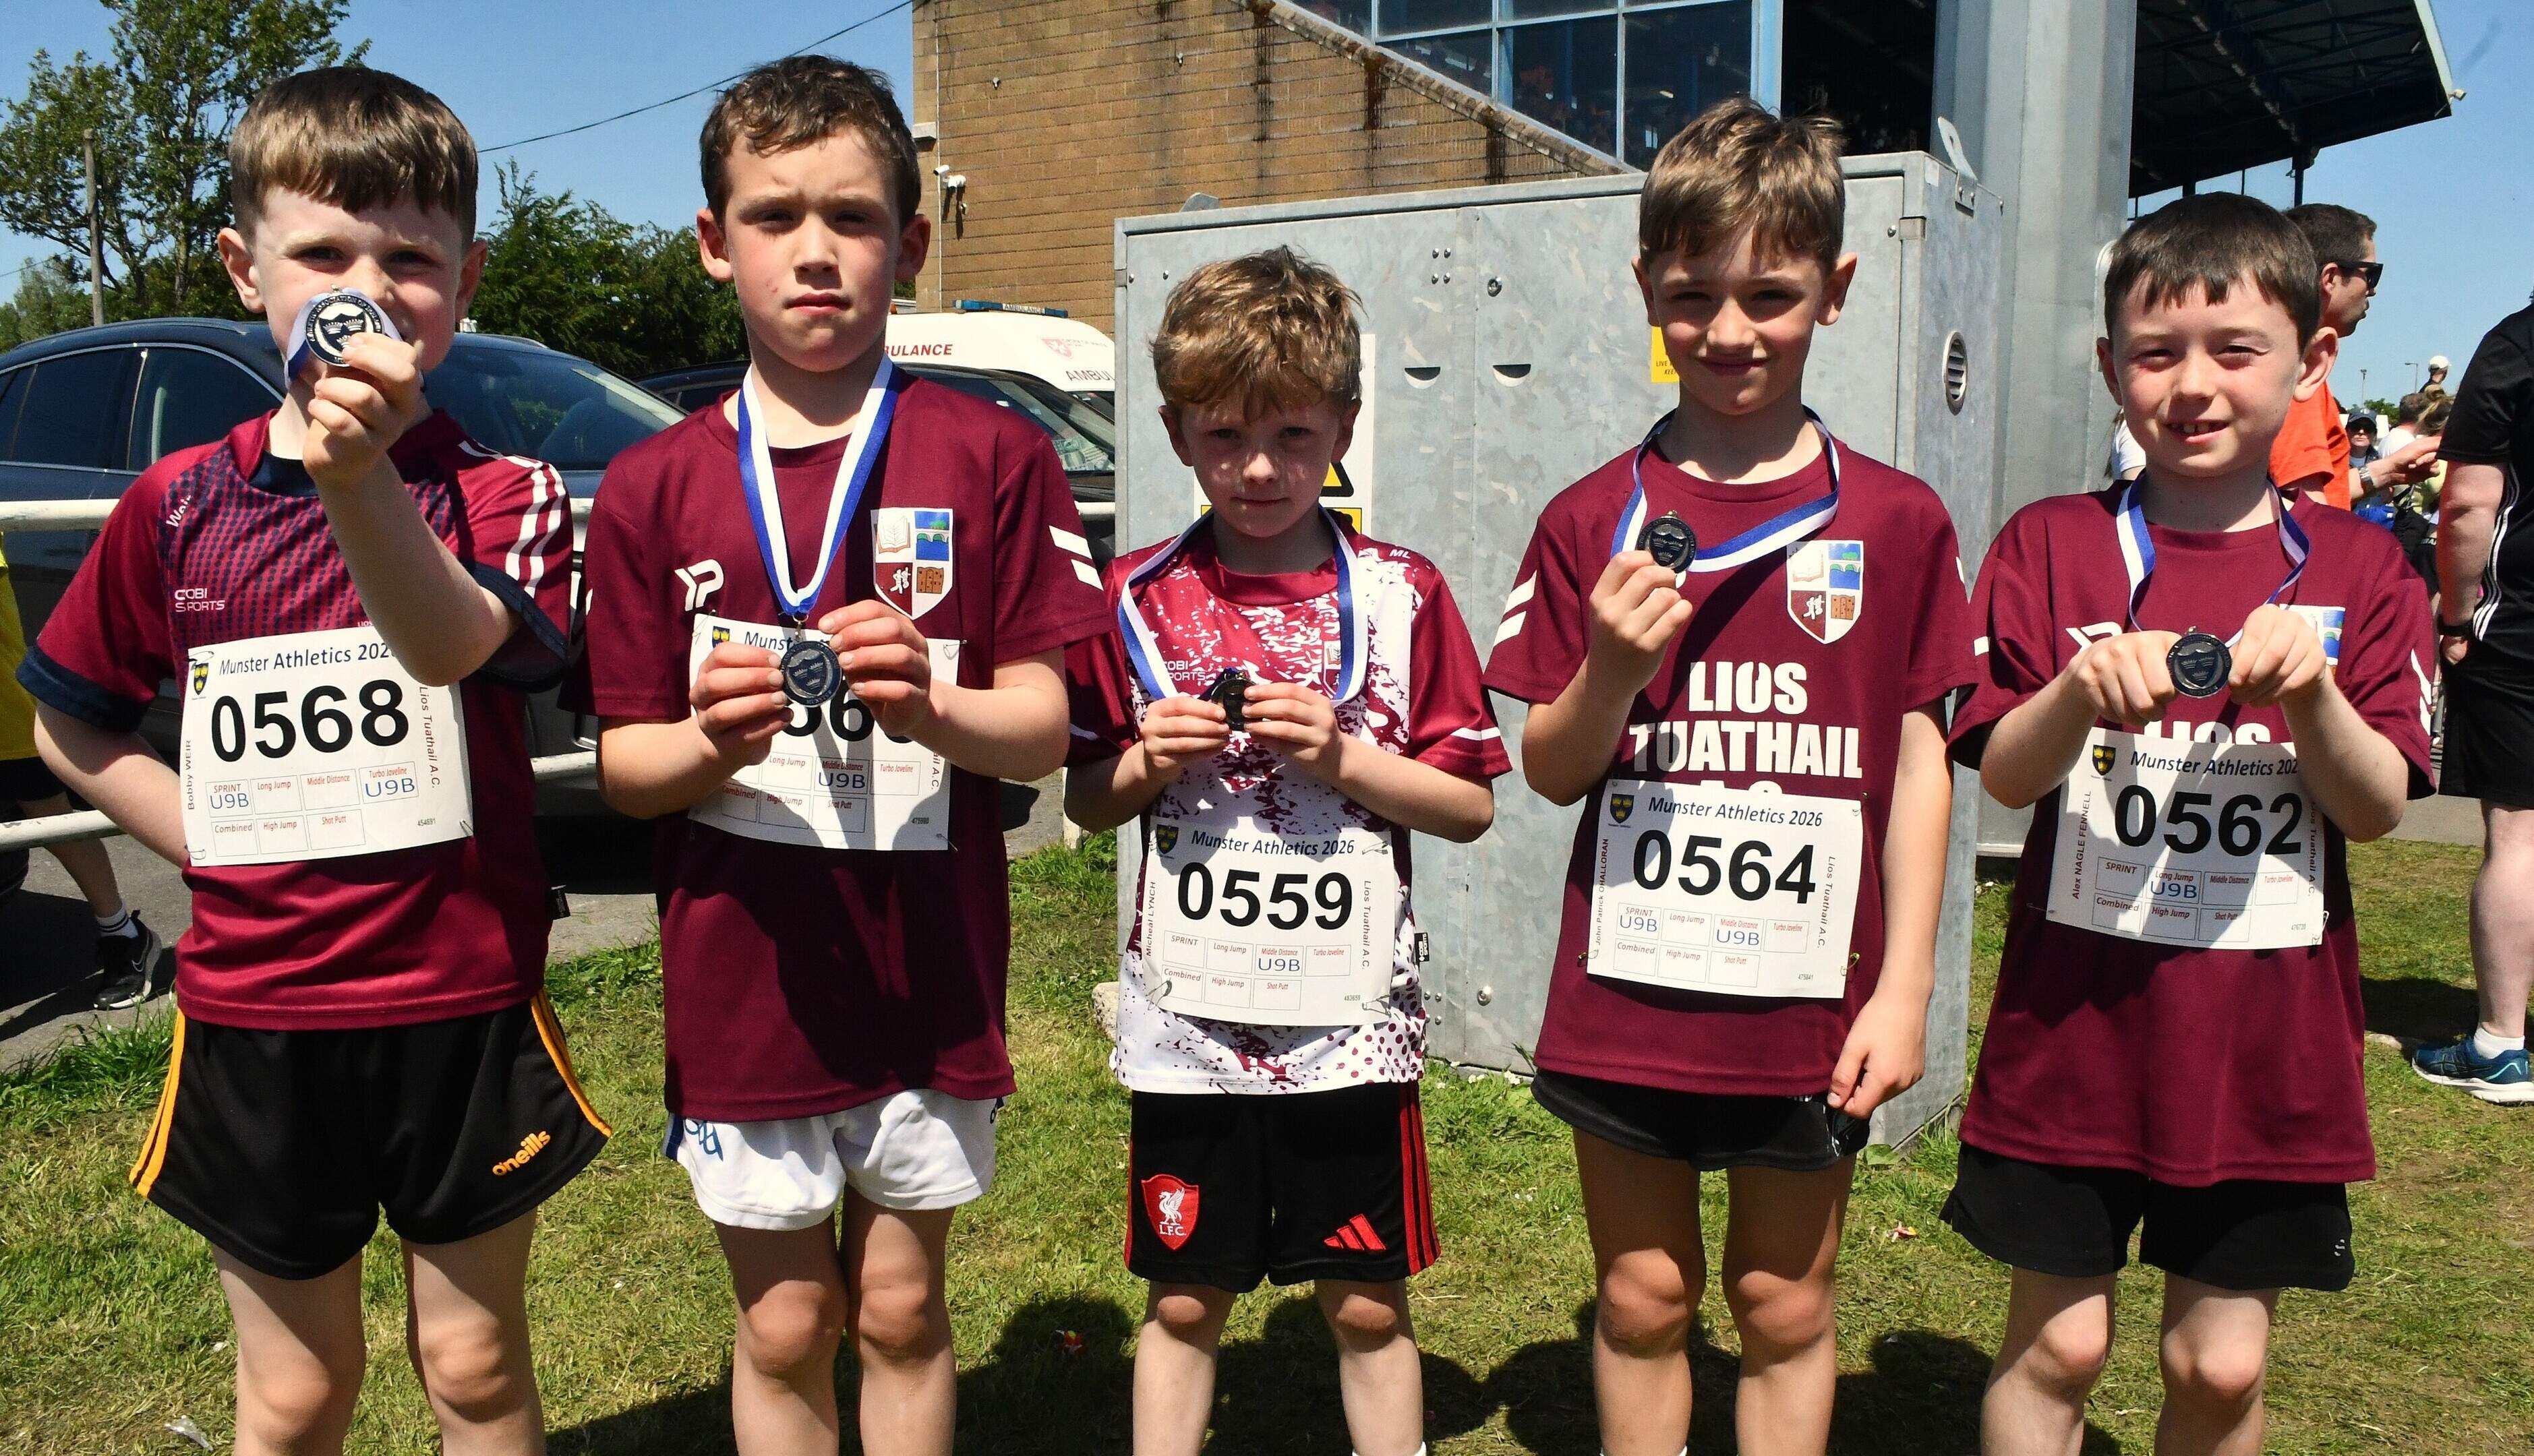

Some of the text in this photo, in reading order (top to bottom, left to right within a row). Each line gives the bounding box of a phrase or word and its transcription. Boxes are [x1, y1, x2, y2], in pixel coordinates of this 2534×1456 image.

[885, 344, 953, 357] BULANCE
[1065, 370, 1115, 381] AMBUL
[1389, 549, 1411, 559] ML
[174, 588, 208, 601] COBI
[175, 600, 225, 612] SPORTS
[744, 631, 793, 651] Munst
[219, 642, 390, 675] Munster Athletics 202
[1164, 660, 1188, 671] OBI
[1169, 671, 1206, 681] PORTS
[1688, 661, 1808, 715] LIOS
[211, 679, 409, 762] 0568
[419, 686, 440, 789] Lios Tuathail A.C.
[1628, 719, 1863, 779] TUATHAIL
[769, 755, 806, 768] Long Jump
[822, 760, 864, 771] Middle Distance
[880, 764, 894, 772] Turbo
[2130, 750, 2298, 776] Munster Athletics 202
[307, 775, 351, 785] Middle Distance
[369, 770, 385, 778] Turbo
[818, 772, 866, 789] U9B
[185, 775, 195, 810] Bobby
[214, 783, 241, 793] SPRINT
[257, 781, 291, 791] Long Jump
[365, 777, 415, 797] U9B
[722, 785, 756, 799] Combined
[210, 793, 249, 810] U9B
[767, 793, 802, 806] High Jump
[827, 799, 852, 810] Shot Putt
[1648, 796, 1823, 826] Munster Athletics 2026
[263, 820, 297, 831] High Jump
[321, 814, 347, 824] Shot Putt
[2115, 784, 2303, 857] 0562
[214, 824, 253, 833] Combined
[1191, 830, 1355, 855] Munster Athletics 2026
[2072, 791, 2091, 900] Alex NAGLE FENNELL
[2309, 828, 2317, 872] Tuathail
[1598, 838, 1609, 893] OHALLORAN
[1633, 829, 1816, 904] 0564
[2105, 861, 2138, 874] SPRINT
[2155, 870, 2193, 883] Long Jump
[2210, 875, 2249, 884] Middle Distance
[1177, 861, 1353, 930] 0559
[2150, 880, 2197, 899] U9B
[1817, 856, 1836, 948] Lios Tuathail A.C.
[2096, 897, 2140, 911] Combined
[1596, 895, 1604, 923] Patrick
[1625, 907, 1653, 917] SPRINT
[2151, 907, 2190, 919] High Jump
[1669, 913, 1705, 925] Long Jump
[2214, 912, 2228, 920] Shot
[1361, 880, 1372, 970] Lios Tuathail A.C.
[1620, 915, 1657, 932] U9B
[1720, 918, 1759, 930] Middle Distance
[1171, 935, 1198, 946] SPRINT
[1716, 928, 1760, 946] U9B
[1213, 942, 1247, 954] Long Jump
[1261, 948, 1298, 957] Middle Distance
[1617, 942, 1655, 954] Combined
[1666, 949, 1701, 961] High Jump
[1724, 956, 1746, 965] Shot Putt
[1258, 958, 1300, 972] U9B
[1164, 968, 1202, 981] Combined
[1212, 977, 1245, 988] High Jump
[1266, 982, 1277, 990] Shot
[1159, 1224, 1187, 1236] L.F.C.
